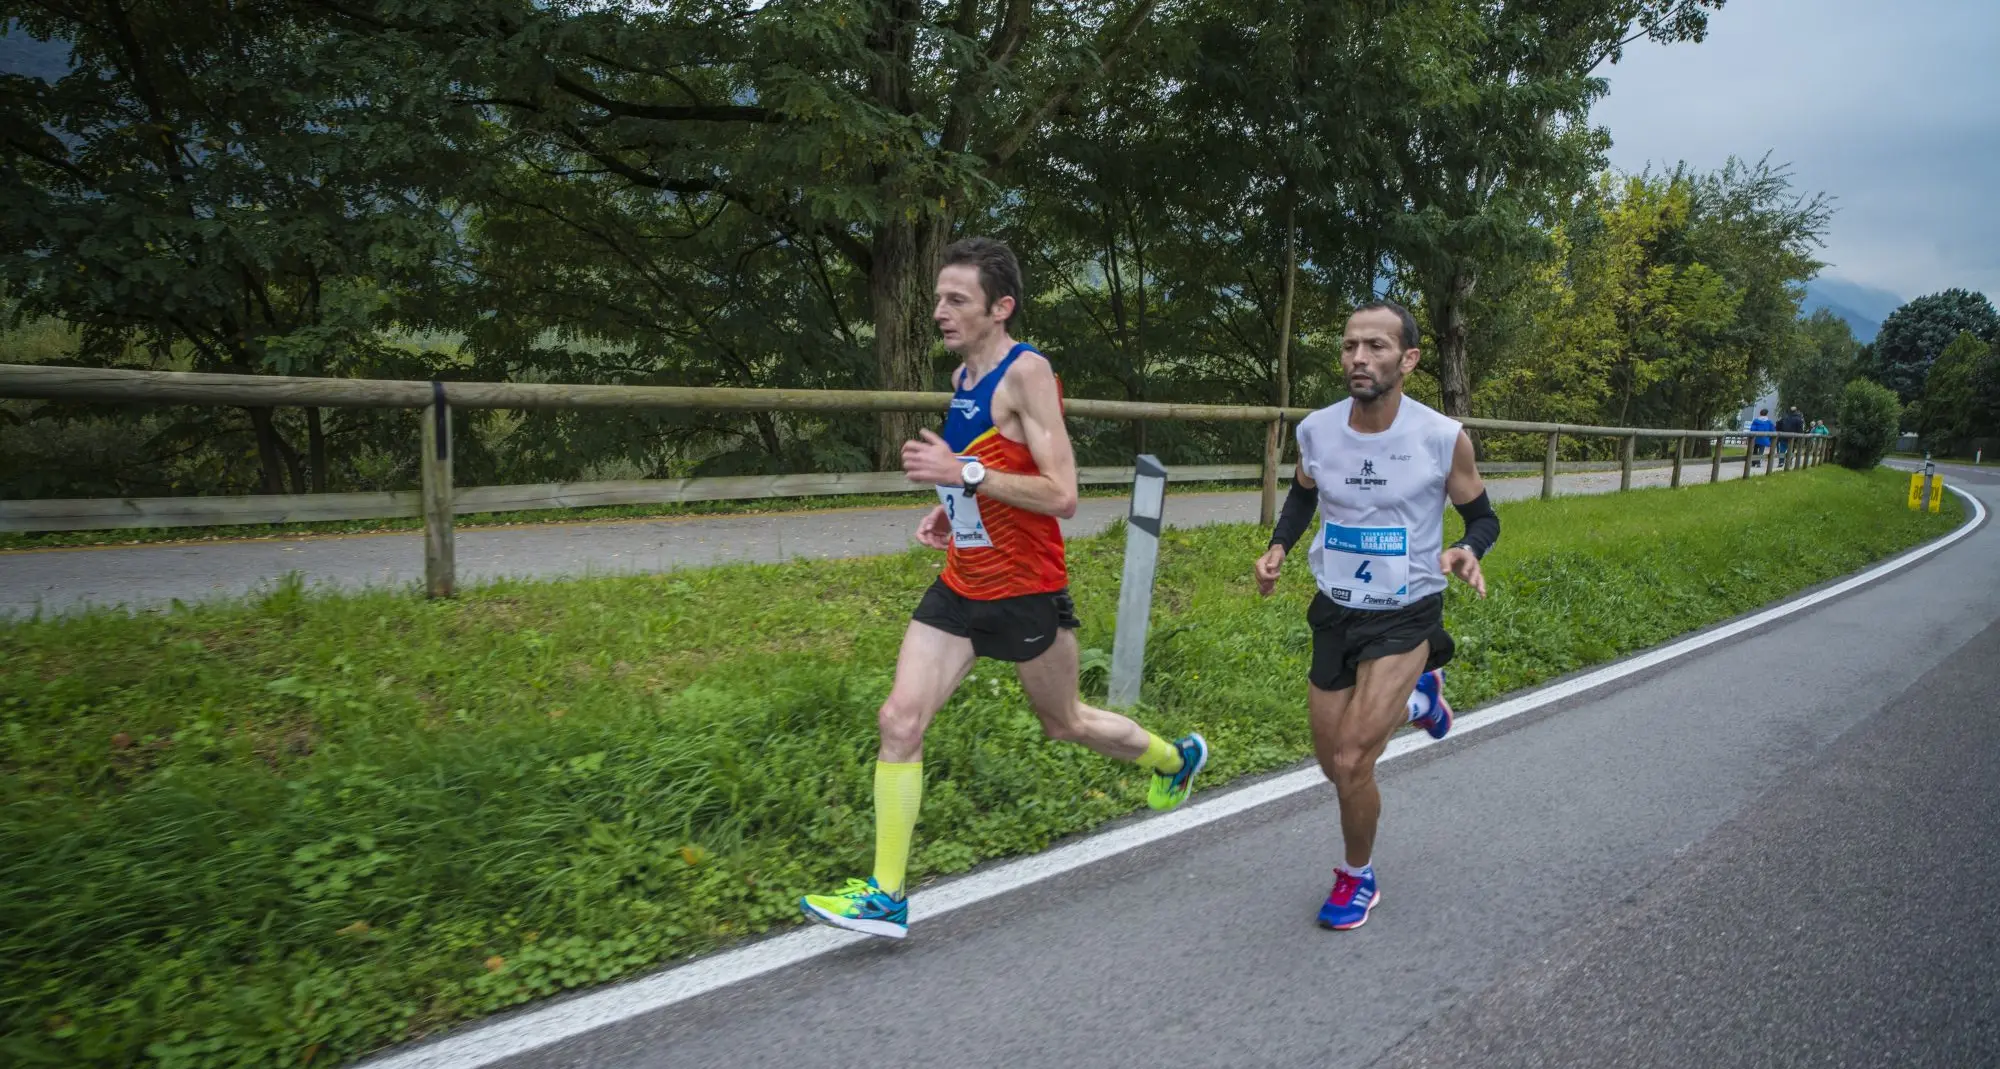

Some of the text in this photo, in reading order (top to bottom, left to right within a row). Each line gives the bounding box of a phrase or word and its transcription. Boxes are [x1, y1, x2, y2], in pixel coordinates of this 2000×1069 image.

[1363, 478, 1388, 486] SPORT
[946, 494, 955, 520] 3
[1361, 542, 1403, 550] MARATHON
[1354, 560, 1373, 583] 4
[1363, 594, 1400, 605] PowerBar
